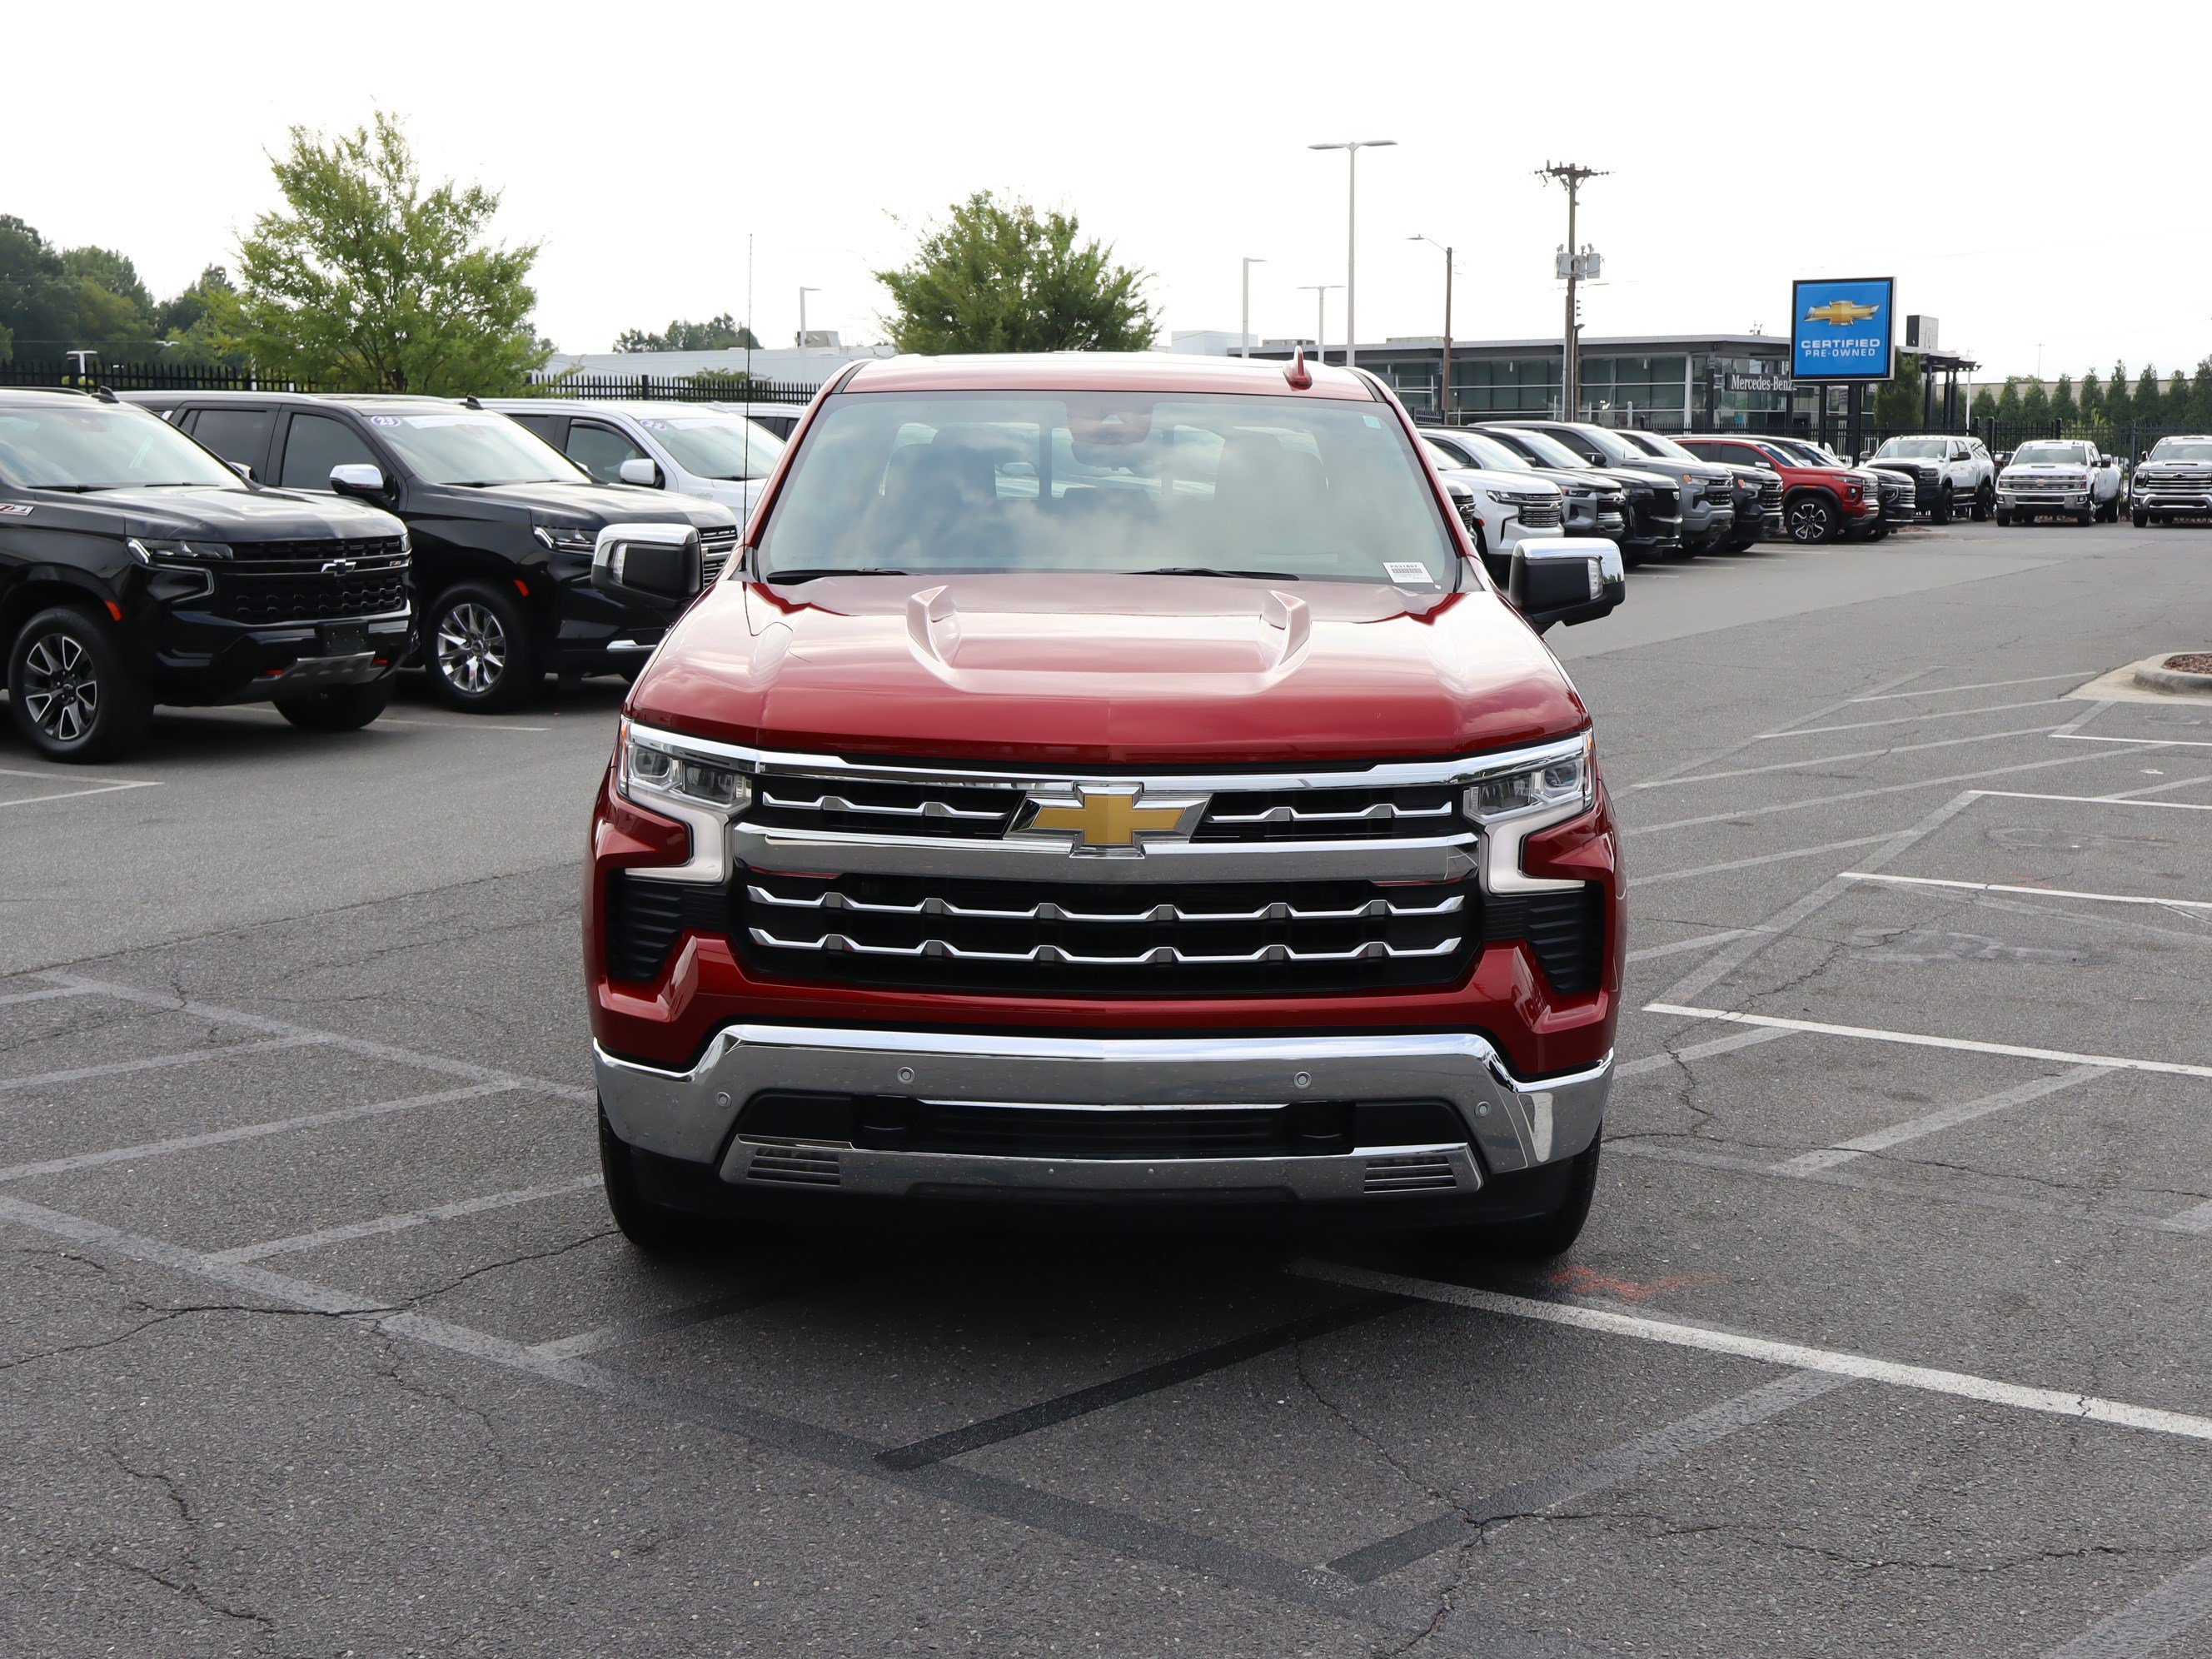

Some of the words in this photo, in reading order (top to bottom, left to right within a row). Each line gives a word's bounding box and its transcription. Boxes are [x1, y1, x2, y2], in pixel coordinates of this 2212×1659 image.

[1801, 339, 1881, 349] CERTIFIED
[1806, 348, 1876, 357] PRE-OWNED
[1731, 374, 1793, 391] Mercedes-Benz
[377, 417, 395, 426] 23
